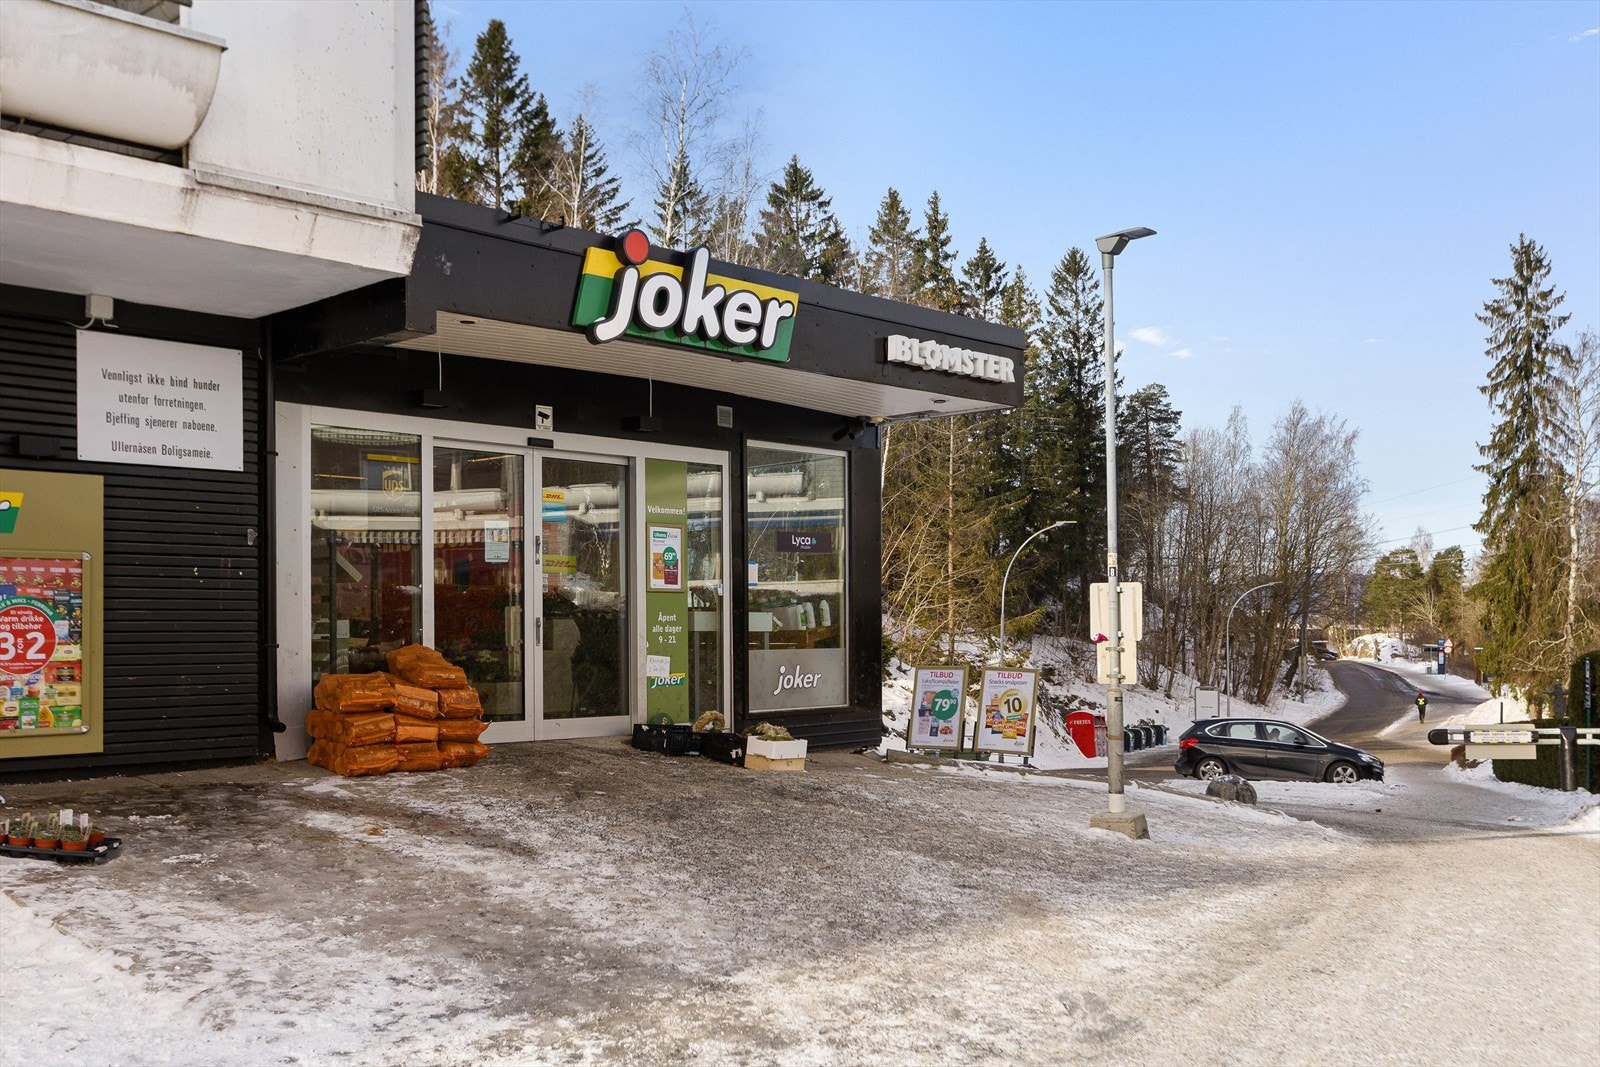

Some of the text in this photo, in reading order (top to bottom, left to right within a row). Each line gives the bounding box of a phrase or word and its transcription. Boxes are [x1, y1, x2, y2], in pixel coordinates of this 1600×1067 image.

[593, 228, 796, 349] joker
[888, 334, 1016, 383] BLOMSTER
[101, 367, 221, 392] Vennligst ikke bind hunder
[118, 393, 206, 412] utenfor forretningen.
[105, 411, 217, 433] Bjeffing sjenerer naboene.
[111, 440, 213, 459] Ullernåsen Boligsameie.
[384, 479, 404, 496] UPS
[647, 504, 686, 516] Velkommen!
[791, 534, 811, 547] Lyca
[663, 551, 673, 561] 69
[544, 559, 571, 567] DHL
[1110, 567, 1115, 577] 8
[20, 614, 44, 623] drikke
[658, 611, 677, 623] Åpent
[0, 624, 11, 632] og
[652, 624, 682, 634] alle dager
[0, 631, 16, 661] 3
[25, 631, 46, 660] 2
[658, 635, 663, 644] 9
[668, 635, 676, 644] 21
[773, 664, 822, 696] joker
[997, 671, 1023, 679] TILBUD
[934, 698, 950, 711] 79
[1004, 697, 1023, 714] 10
